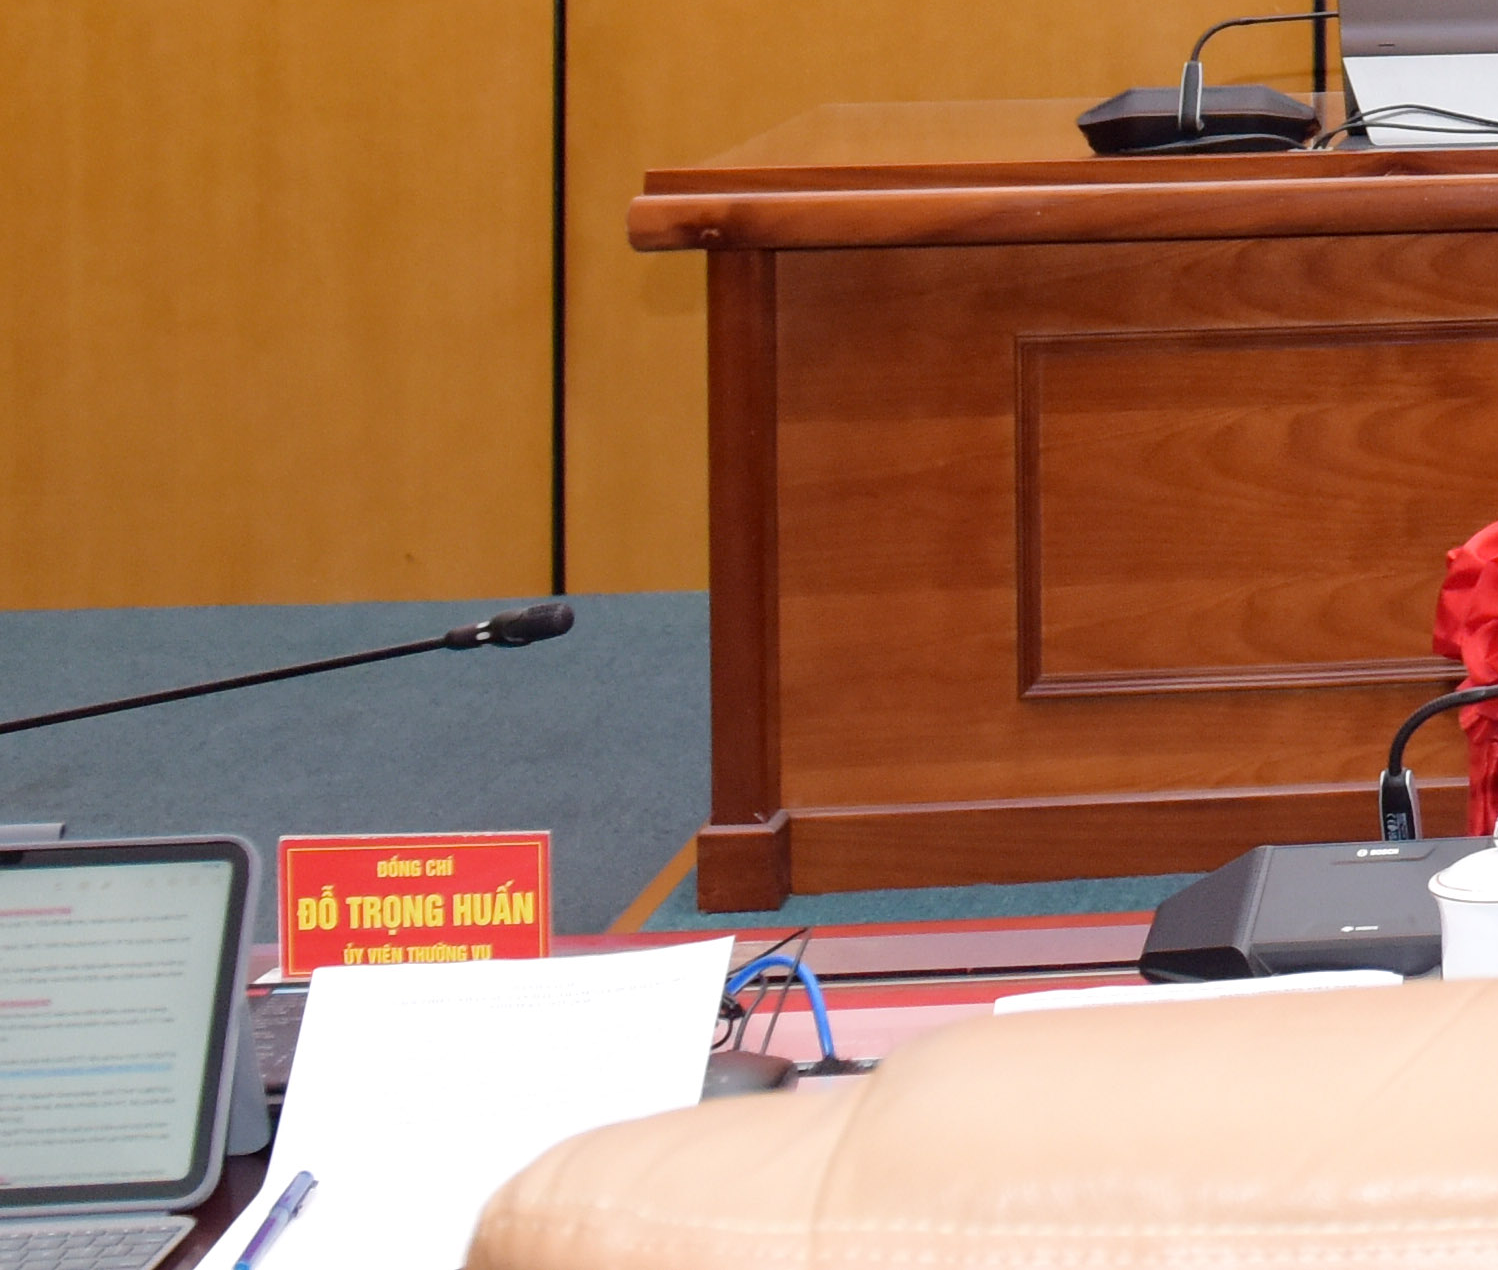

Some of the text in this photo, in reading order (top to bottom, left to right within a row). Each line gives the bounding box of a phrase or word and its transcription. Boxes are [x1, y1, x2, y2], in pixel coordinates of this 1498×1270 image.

[426, 856, 454, 876] CHÍ
[297, 880, 535, 935] ĐỖ TRỌNG HUẤN
[368, 944, 403, 963] VIÊN
[407, 943, 467, 961] THƯỜNG
